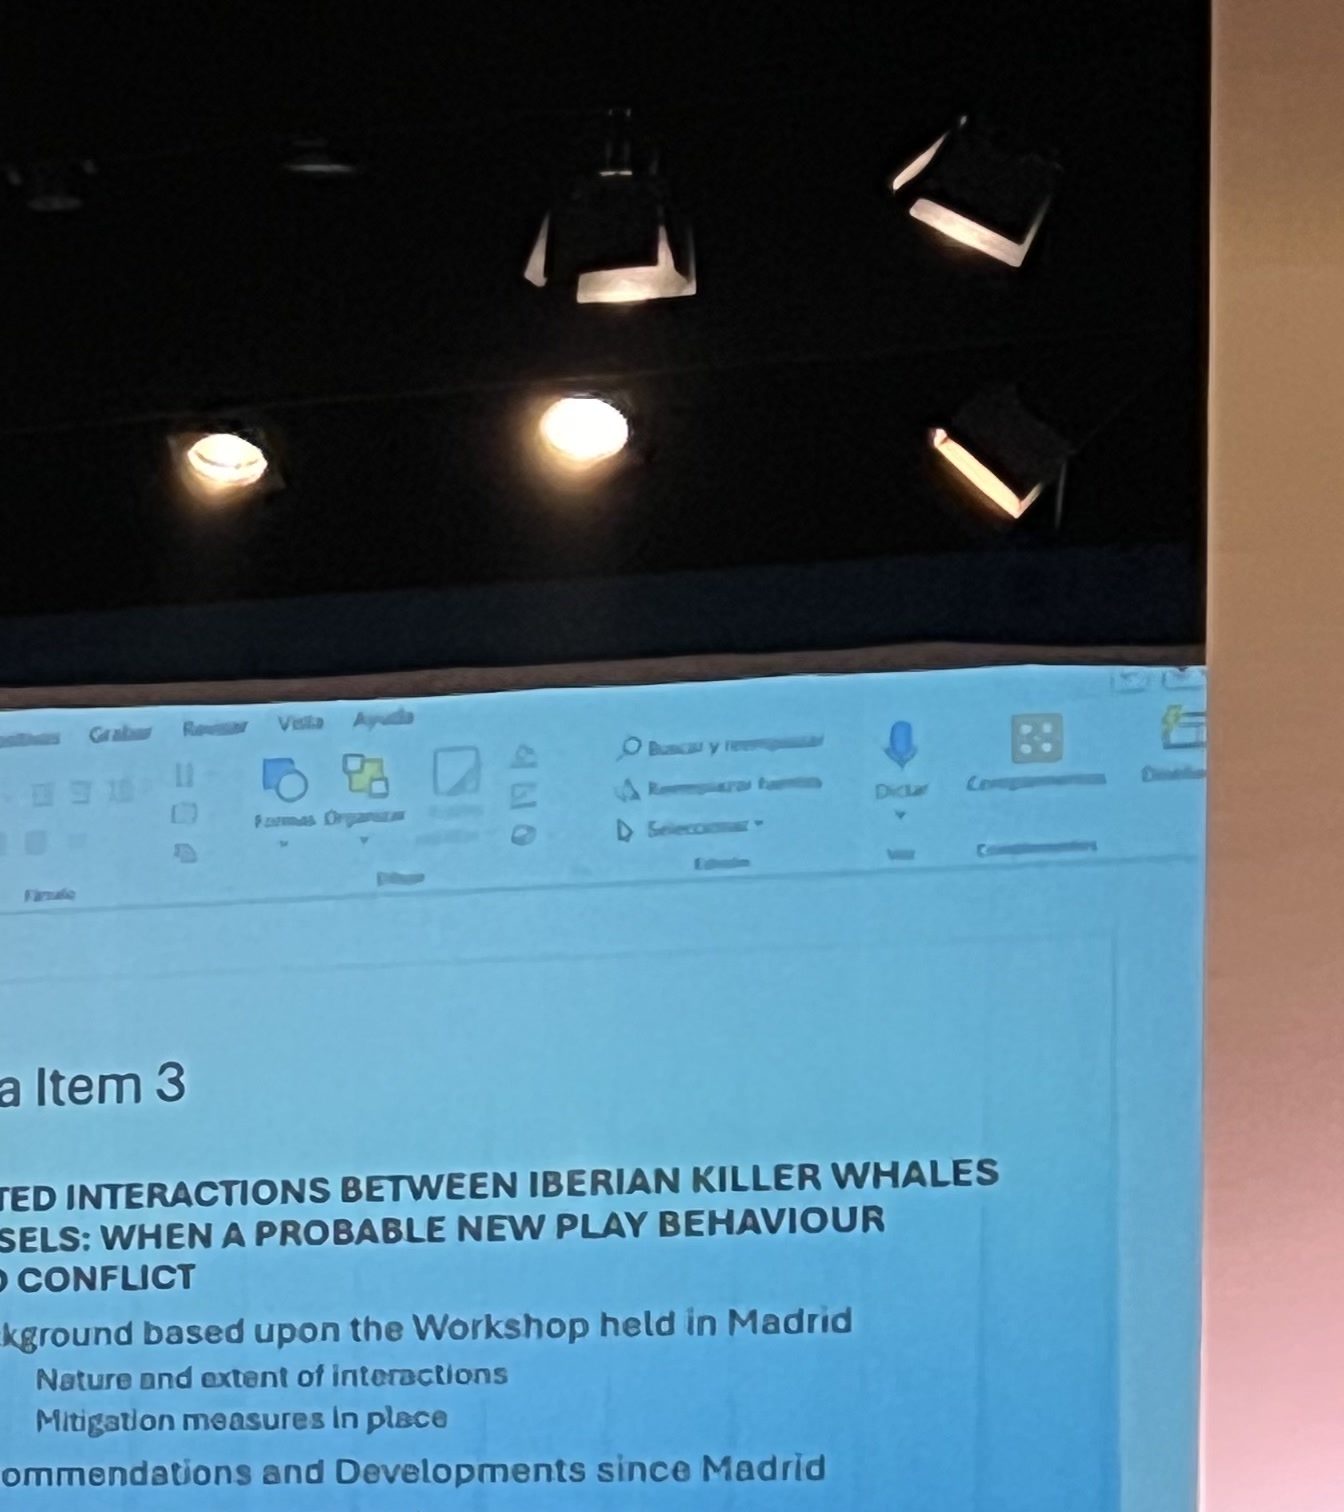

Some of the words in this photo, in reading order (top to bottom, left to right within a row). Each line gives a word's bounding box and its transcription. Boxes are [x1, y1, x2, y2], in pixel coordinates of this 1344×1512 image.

[37, 1067, 142, 1107] Item
[156, 1061, 185, 1103] 3
[66, 1177, 331, 1211] INTERACTIONS
[341, 1171, 517, 1203] BETWEEN
[529, 1167, 680, 1198] IBERIAN
[692, 1163, 822, 1194] KILLER
[830, 1158, 999, 1190] WHALES
[100, 1222, 213, 1251] WHEN
[221, 1222, 246, 1249] A
[255, 1215, 446, 1247] PROBABLE
[457, 1213, 546, 1243] NEW
[556, 1211, 649, 1240] PLAY
[659, 1204, 885, 1238] BEHAVIOUR
[17, 1263, 196, 1294] CONFLICT
[144, 1317, 244, 1345] based
[254, 1322, 340, 1350] upon
[350, 1315, 403, 1343] the
[412, 1313, 590, 1345] Workshop
[600, 1310, 675, 1338] held
[687, 1308, 717, 1337] in
[728, 1306, 852, 1337] Madrid
[37, 1368, 132, 1392] Nature
[140, 1365, 193, 1390] and
[201, 1366, 288, 1389] extent
[297, 1363, 324, 1388] of
[332, 1364, 508, 1387] interactions
[36, 1409, 175, 1438] Mitigation
[183, 1412, 325, 1431] measures
[333, 1405, 359, 1429] in
[366, 1405, 447, 1435] place
[262, 1459, 324, 1485] and
[336, 1458, 586, 1489] Developments
[597, 1454, 690, 1483] since
[702, 1452, 825, 1483] Madrid
